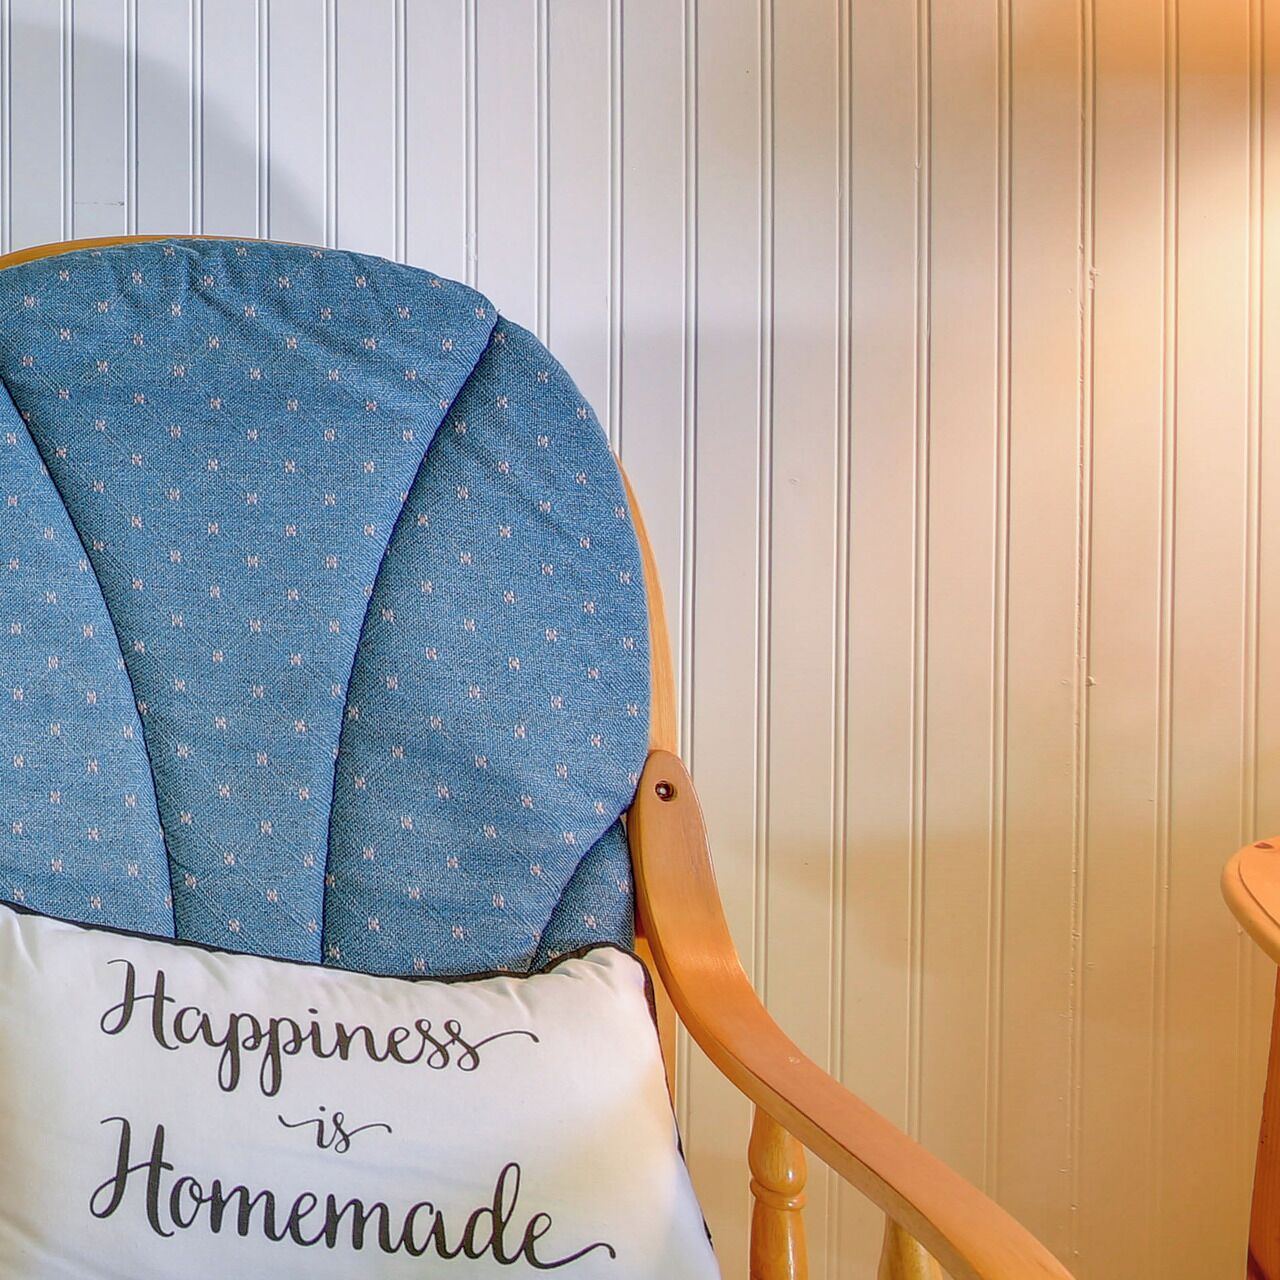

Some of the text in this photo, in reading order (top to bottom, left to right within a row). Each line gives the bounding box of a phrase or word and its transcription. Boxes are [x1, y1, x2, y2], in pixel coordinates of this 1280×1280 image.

[100, 959, 539, 1097] Happiness
[90, 1116, 616, 1269] Homemade
[278, 1106, 392, 1154] is
